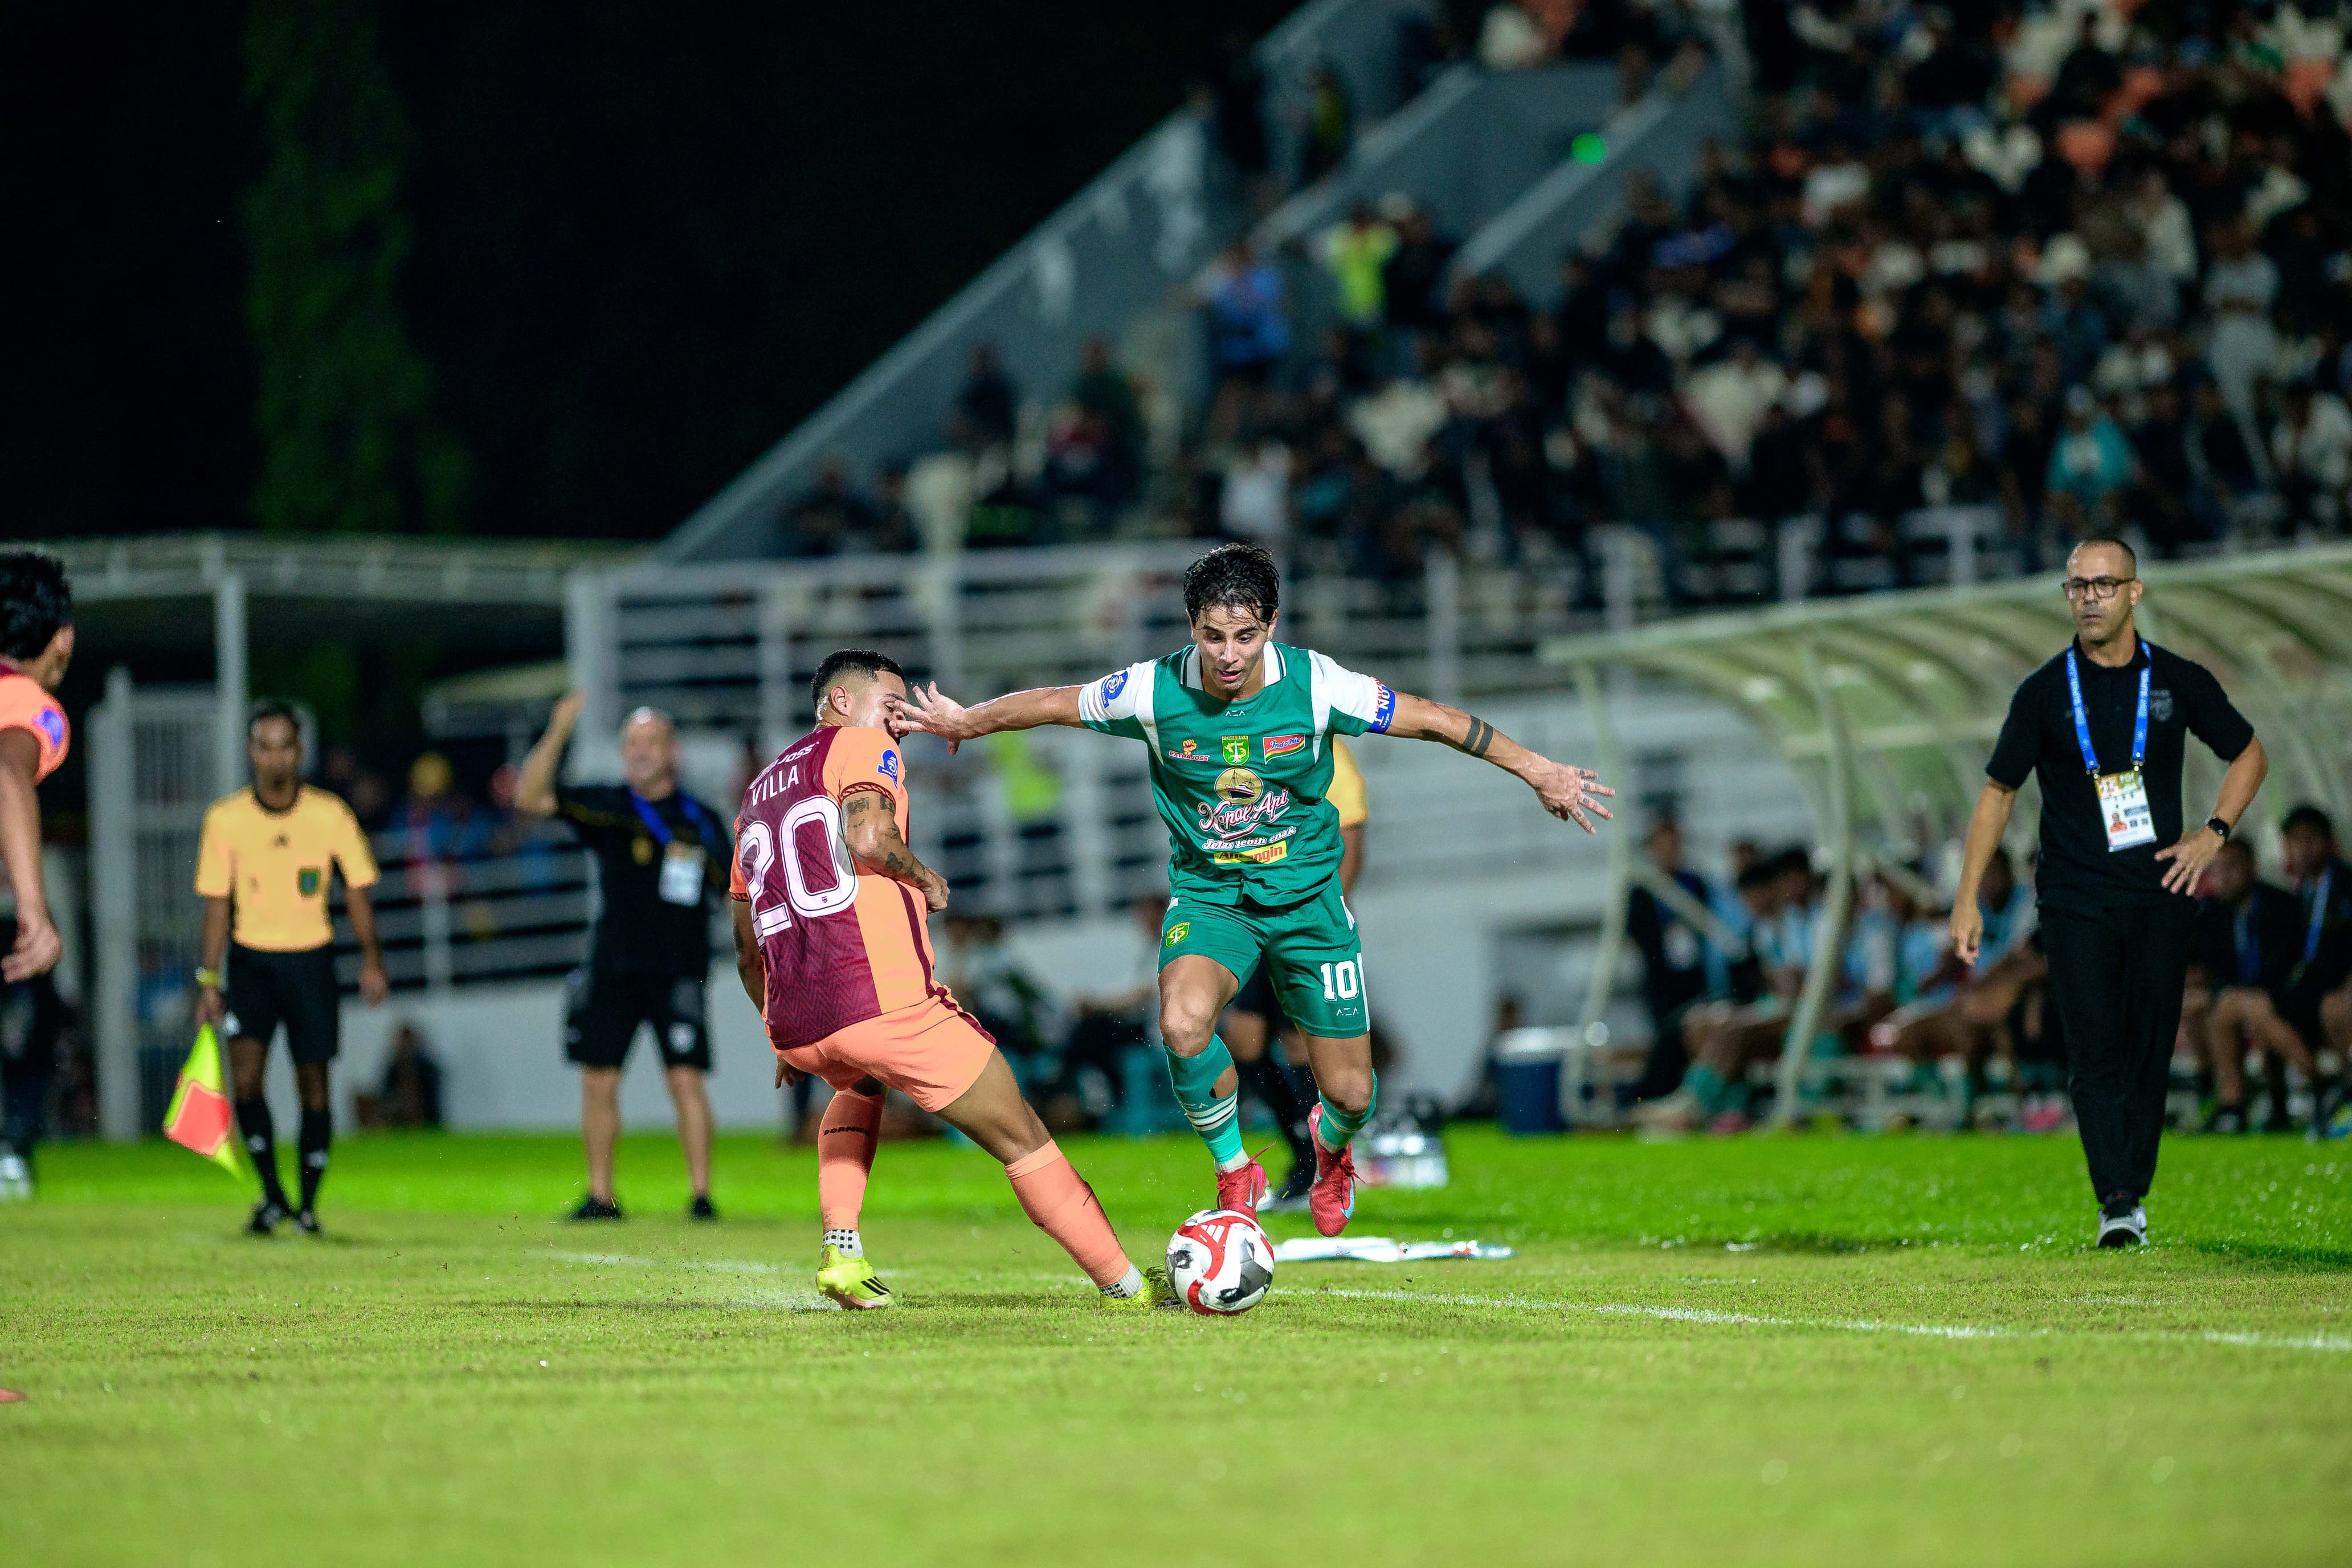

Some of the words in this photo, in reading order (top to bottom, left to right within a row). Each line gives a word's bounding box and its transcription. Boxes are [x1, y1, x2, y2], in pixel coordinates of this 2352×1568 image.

[1267, 737, 1301, 752] Indomie
[752, 765, 799, 807] VILLA
[1198, 799, 1253, 835] Kapal
[1252, 787, 1289, 820] Api
[1202, 839, 1235, 850] Jelas
[1268, 826, 1297, 843] enak
[740, 795, 859, 947] 20
[1320, 960, 1359, 1001] 10
